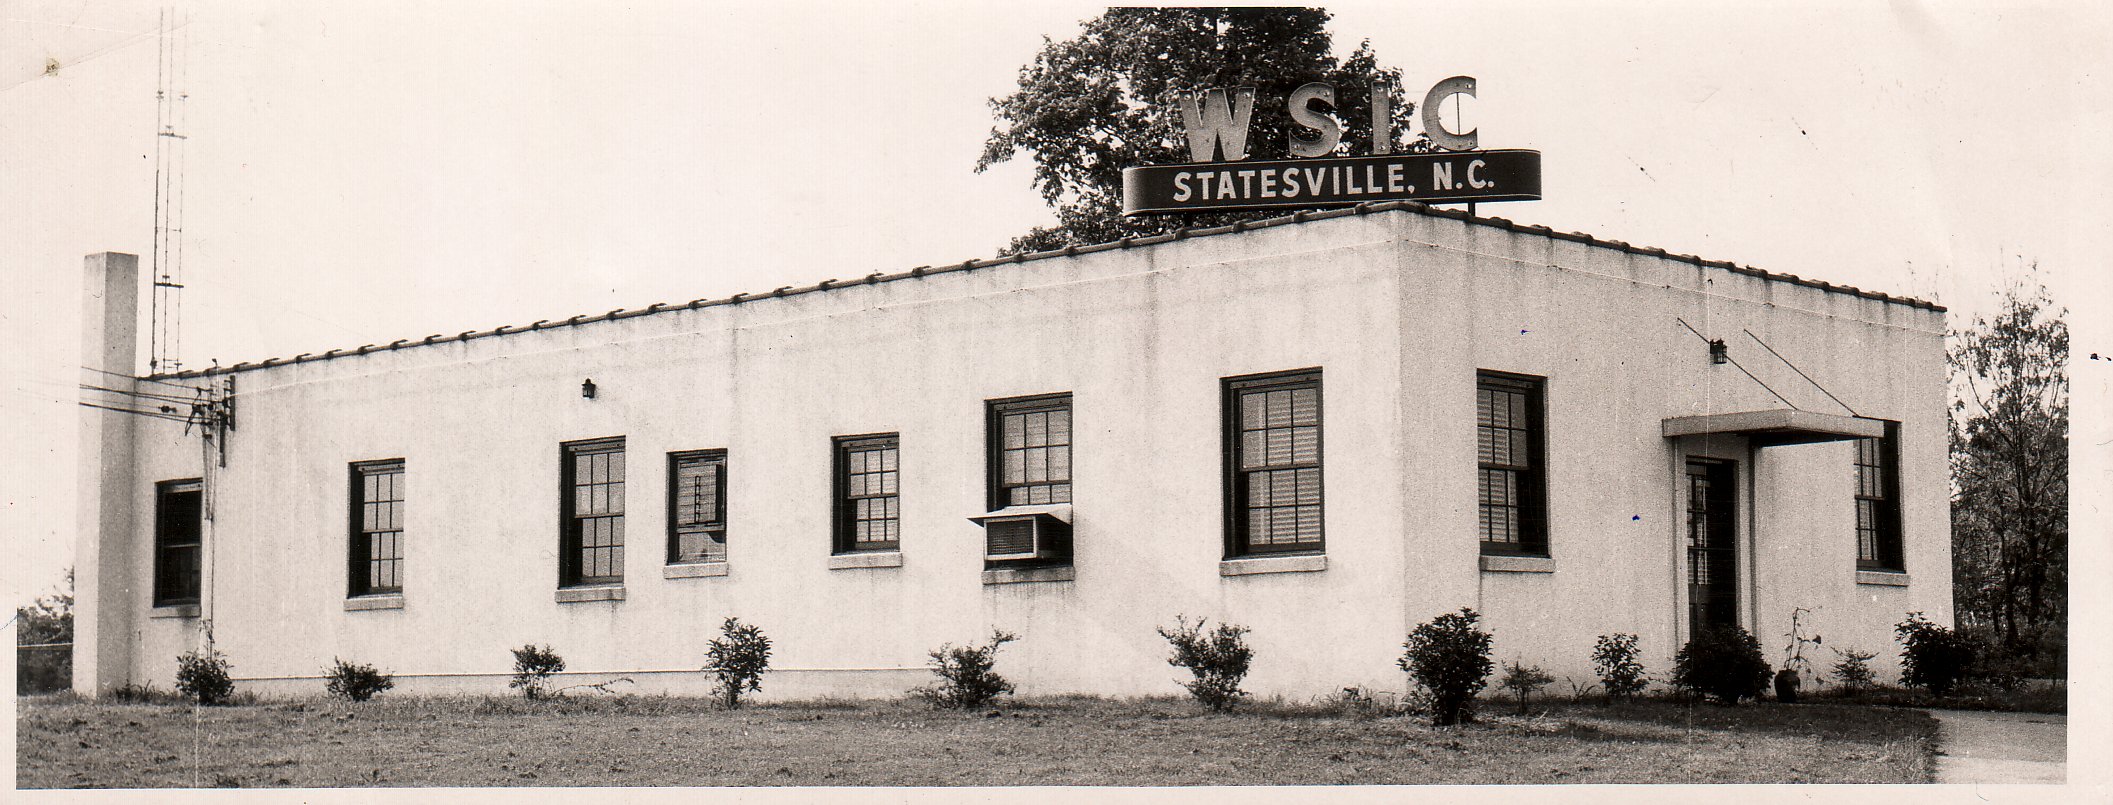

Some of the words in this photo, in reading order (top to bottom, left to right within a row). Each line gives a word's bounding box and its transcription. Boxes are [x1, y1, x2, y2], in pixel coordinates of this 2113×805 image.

[1180, 76, 1478, 161] WSIC
[1173, 163, 1415, 201] STATESVILLE,
[1433, 159, 1495, 191] N.C.
